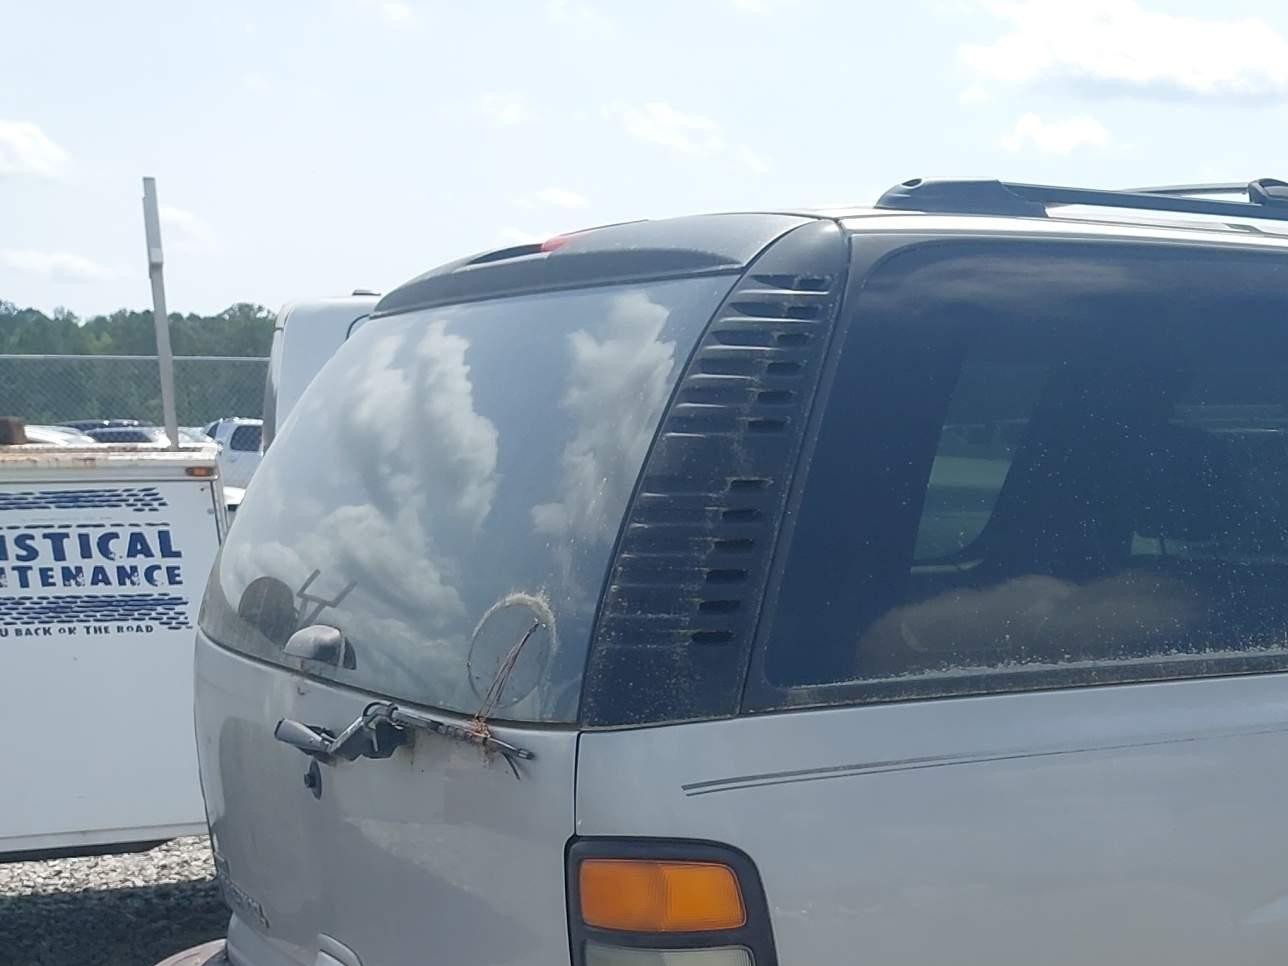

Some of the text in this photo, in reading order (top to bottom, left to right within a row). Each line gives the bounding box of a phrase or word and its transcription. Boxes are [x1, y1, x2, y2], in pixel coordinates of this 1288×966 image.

[15, 627, 52, 637] BACK
[84, 625, 111, 635] THE
[117, 624, 154, 633] ROAD
